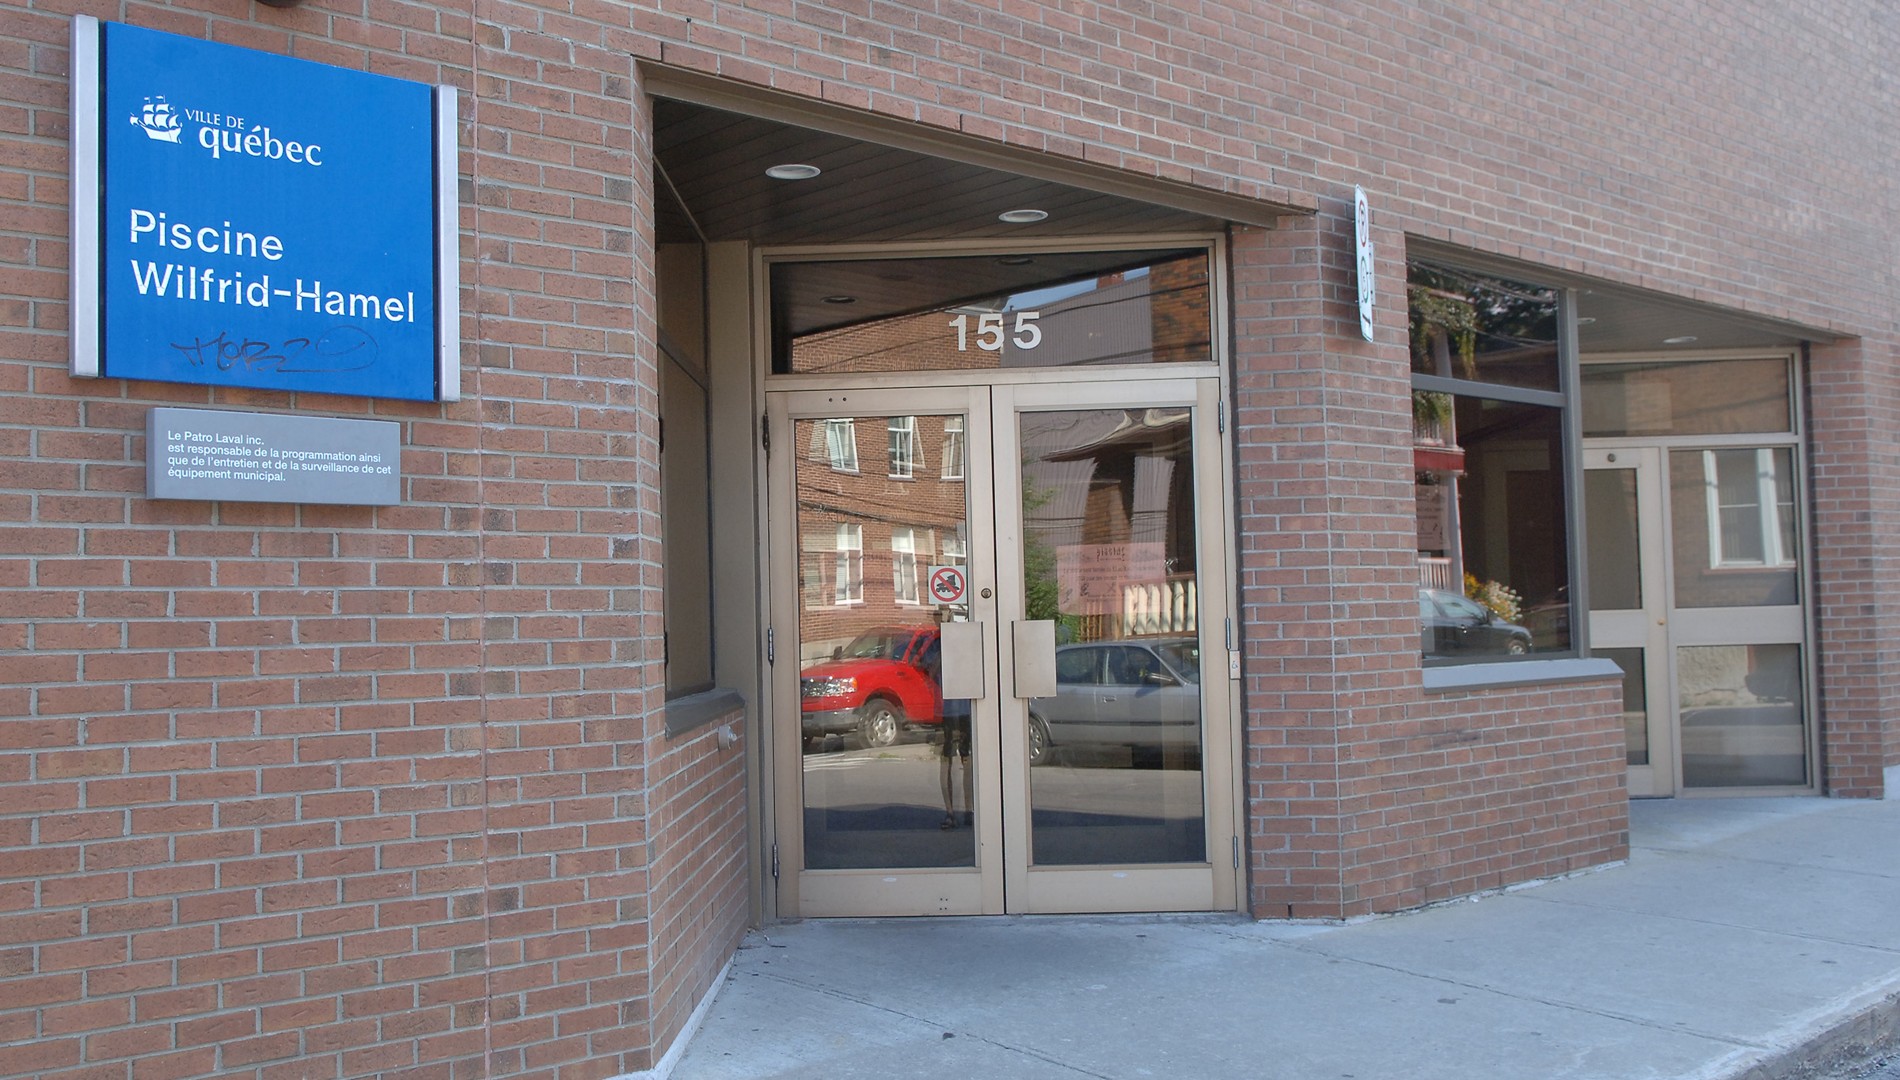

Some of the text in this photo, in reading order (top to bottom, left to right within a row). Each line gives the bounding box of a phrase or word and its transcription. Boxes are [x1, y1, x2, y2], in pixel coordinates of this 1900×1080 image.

[185, 108, 245, 130] VILLE DE
[199, 125, 322, 166] québec
[130, 208, 284, 261] Piscine
[130, 259, 415, 323] Wilfrid-Hamel
[948, 311, 1042, 351] 155
[167, 430, 265, 446] Le Patro Laval inc.
[167, 443, 381, 463] est responsable de la programmation ainsi
[167, 456, 392, 475] que de l'entretien et de la surveillance de cet
[167, 466, 286, 483] équipement municipal.
